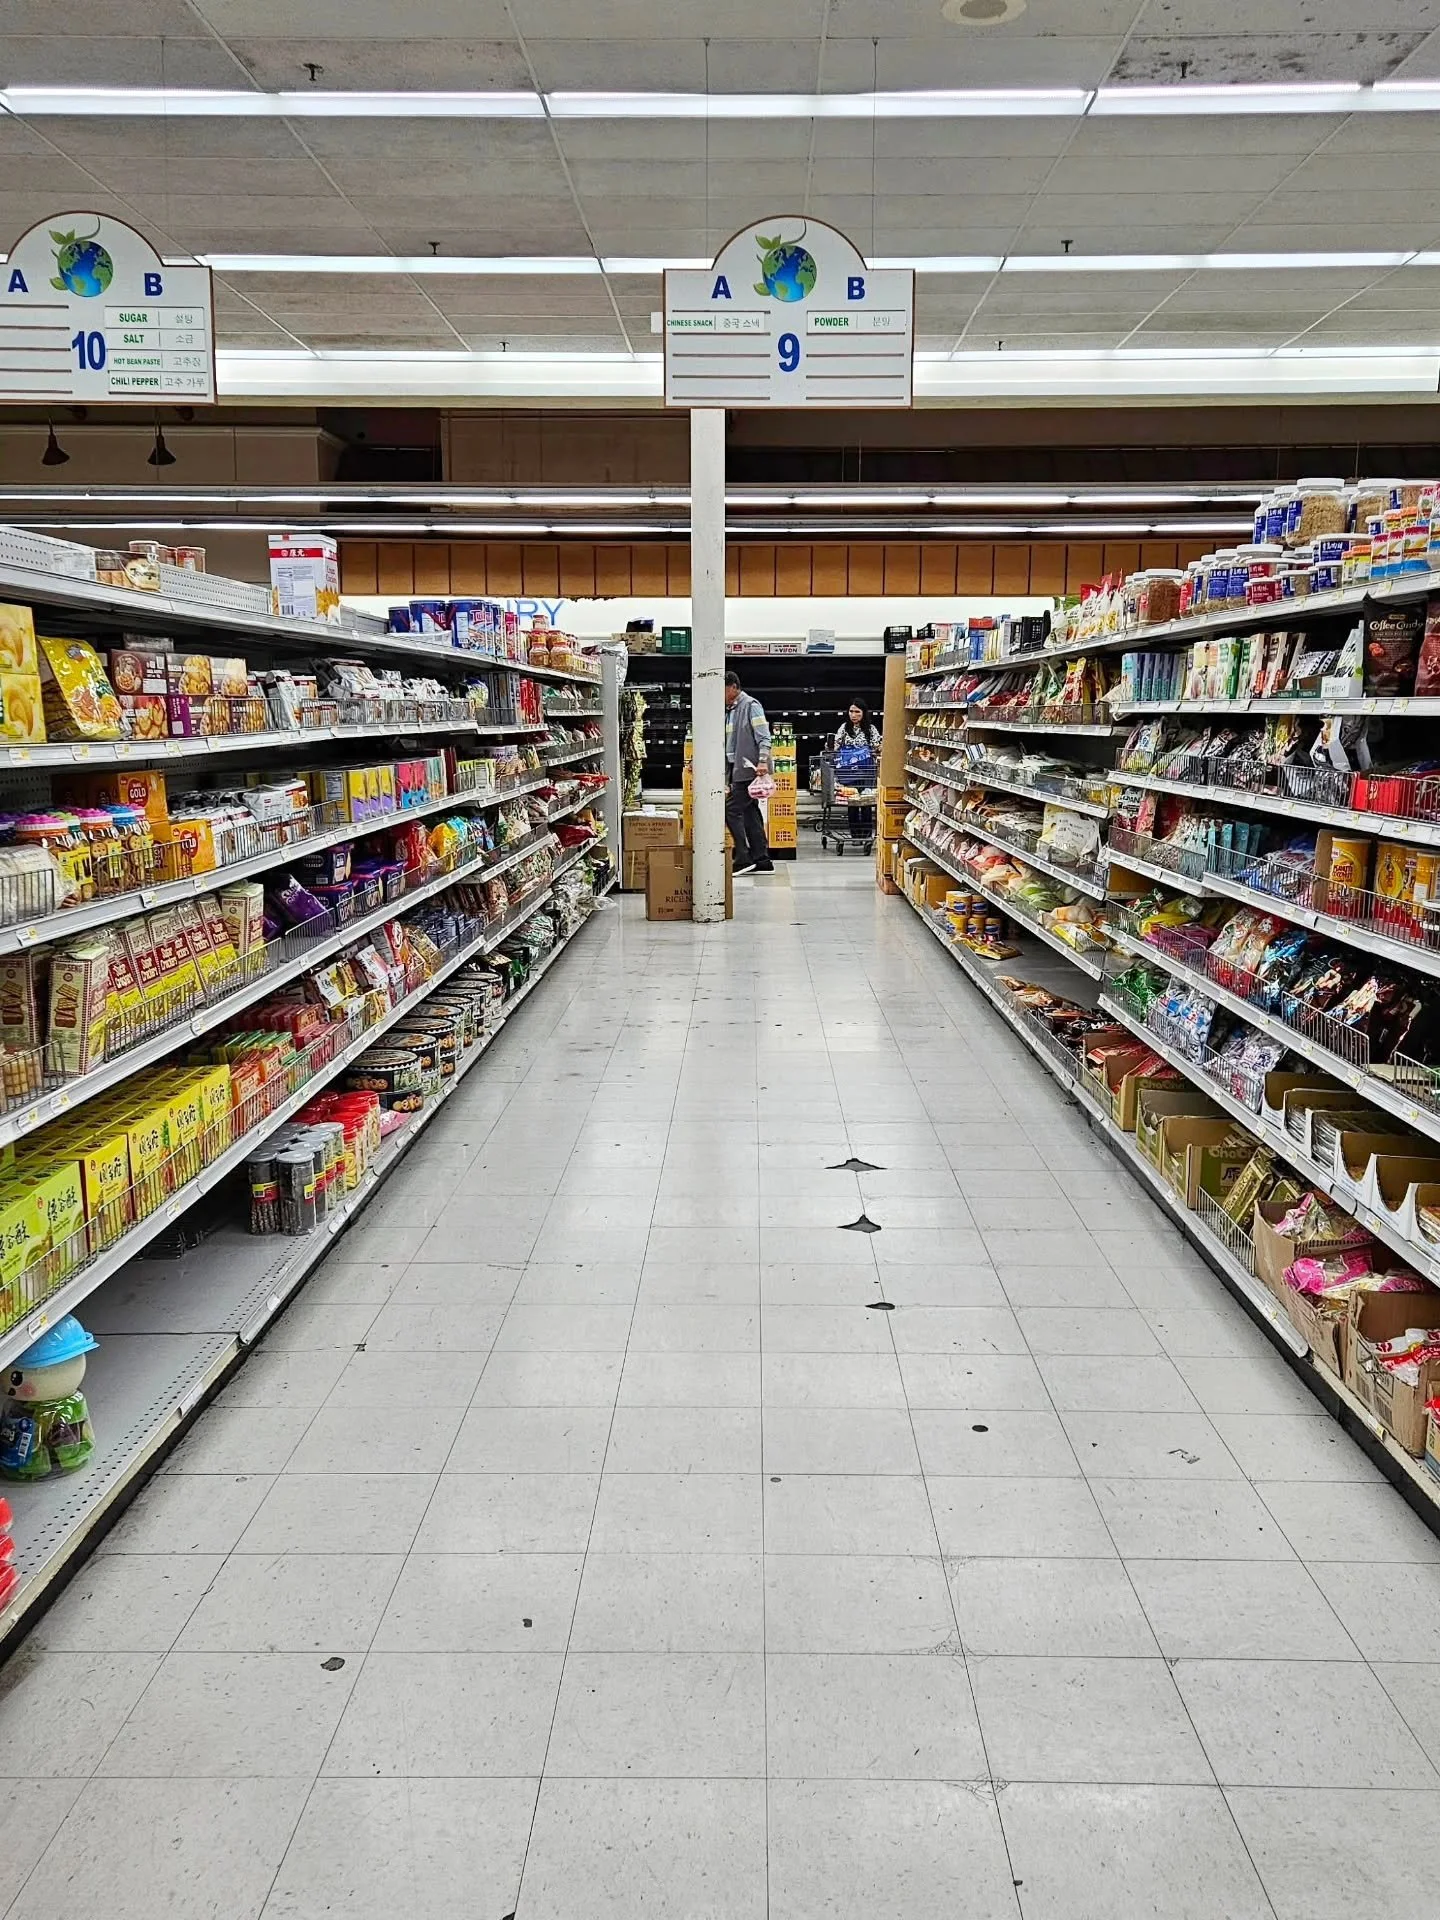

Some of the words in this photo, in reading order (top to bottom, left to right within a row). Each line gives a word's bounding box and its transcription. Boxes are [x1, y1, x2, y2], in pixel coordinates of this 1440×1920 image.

[8, 269, 29, 292] A
[144, 273, 163, 296] B
[711, 276, 732, 299] A
[847, 277, 865, 300] B
[119, 313, 148, 323] SUGAR
[814, 317, 849, 326] POWDER
[123, 335, 145, 343] SALT
[175, 335, 194, 344] 소금
[71, 331, 106, 370] 10
[777, 333, 800, 373] 9
[127, 358, 142, 366] BEAN
[143, 358, 161, 366] PASTE
[110, 377, 130, 386] CHILI
[132, 378, 159, 386] PEPPER
[506, 600, 565, 626] IRY
[1370, 620, 1396, 631] Coffee
[1396, 620, 1424, 631] Candy
[129, 787, 147, 798] GOLD
